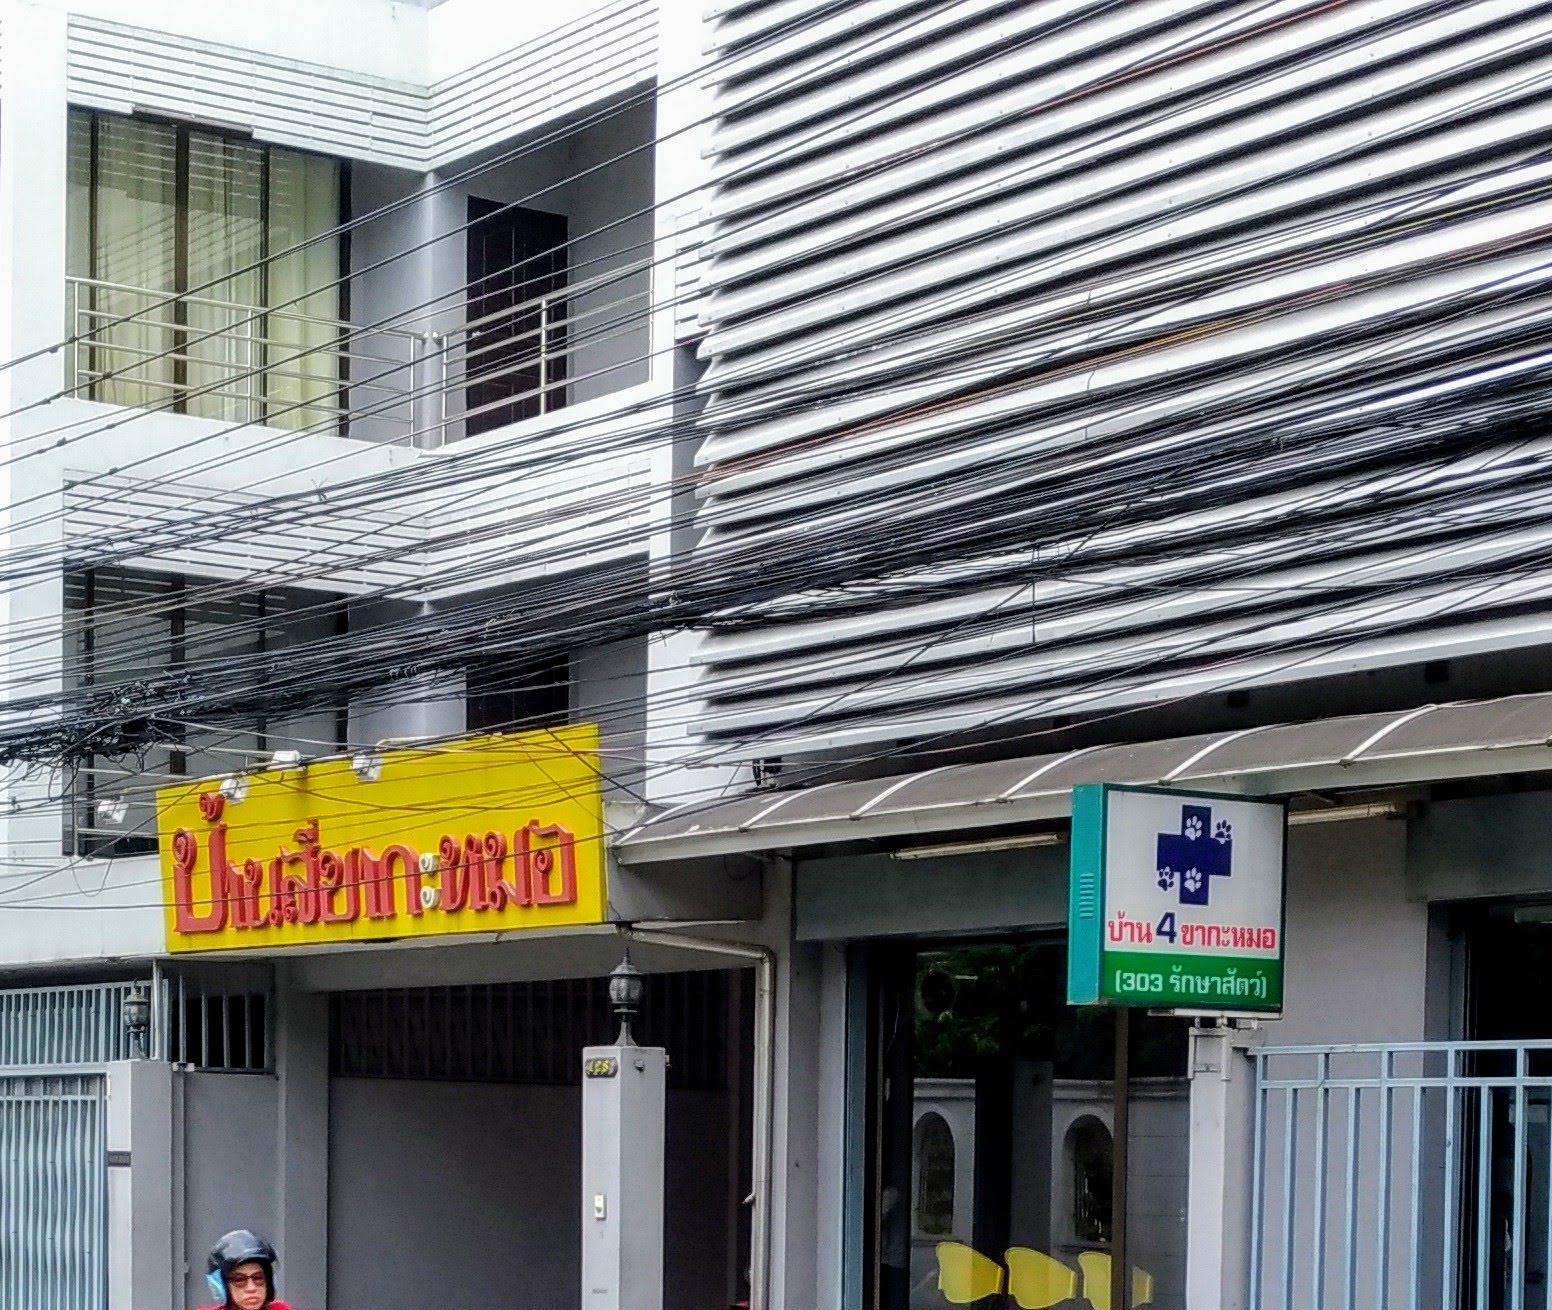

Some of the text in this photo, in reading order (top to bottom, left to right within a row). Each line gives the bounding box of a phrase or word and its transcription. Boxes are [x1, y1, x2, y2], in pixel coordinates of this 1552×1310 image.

[1108, 910, 1277, 950] บ้าน 4 ขากะหมอ
[1115, 965, 1268, 999] (303 รักษาสัตว์)
